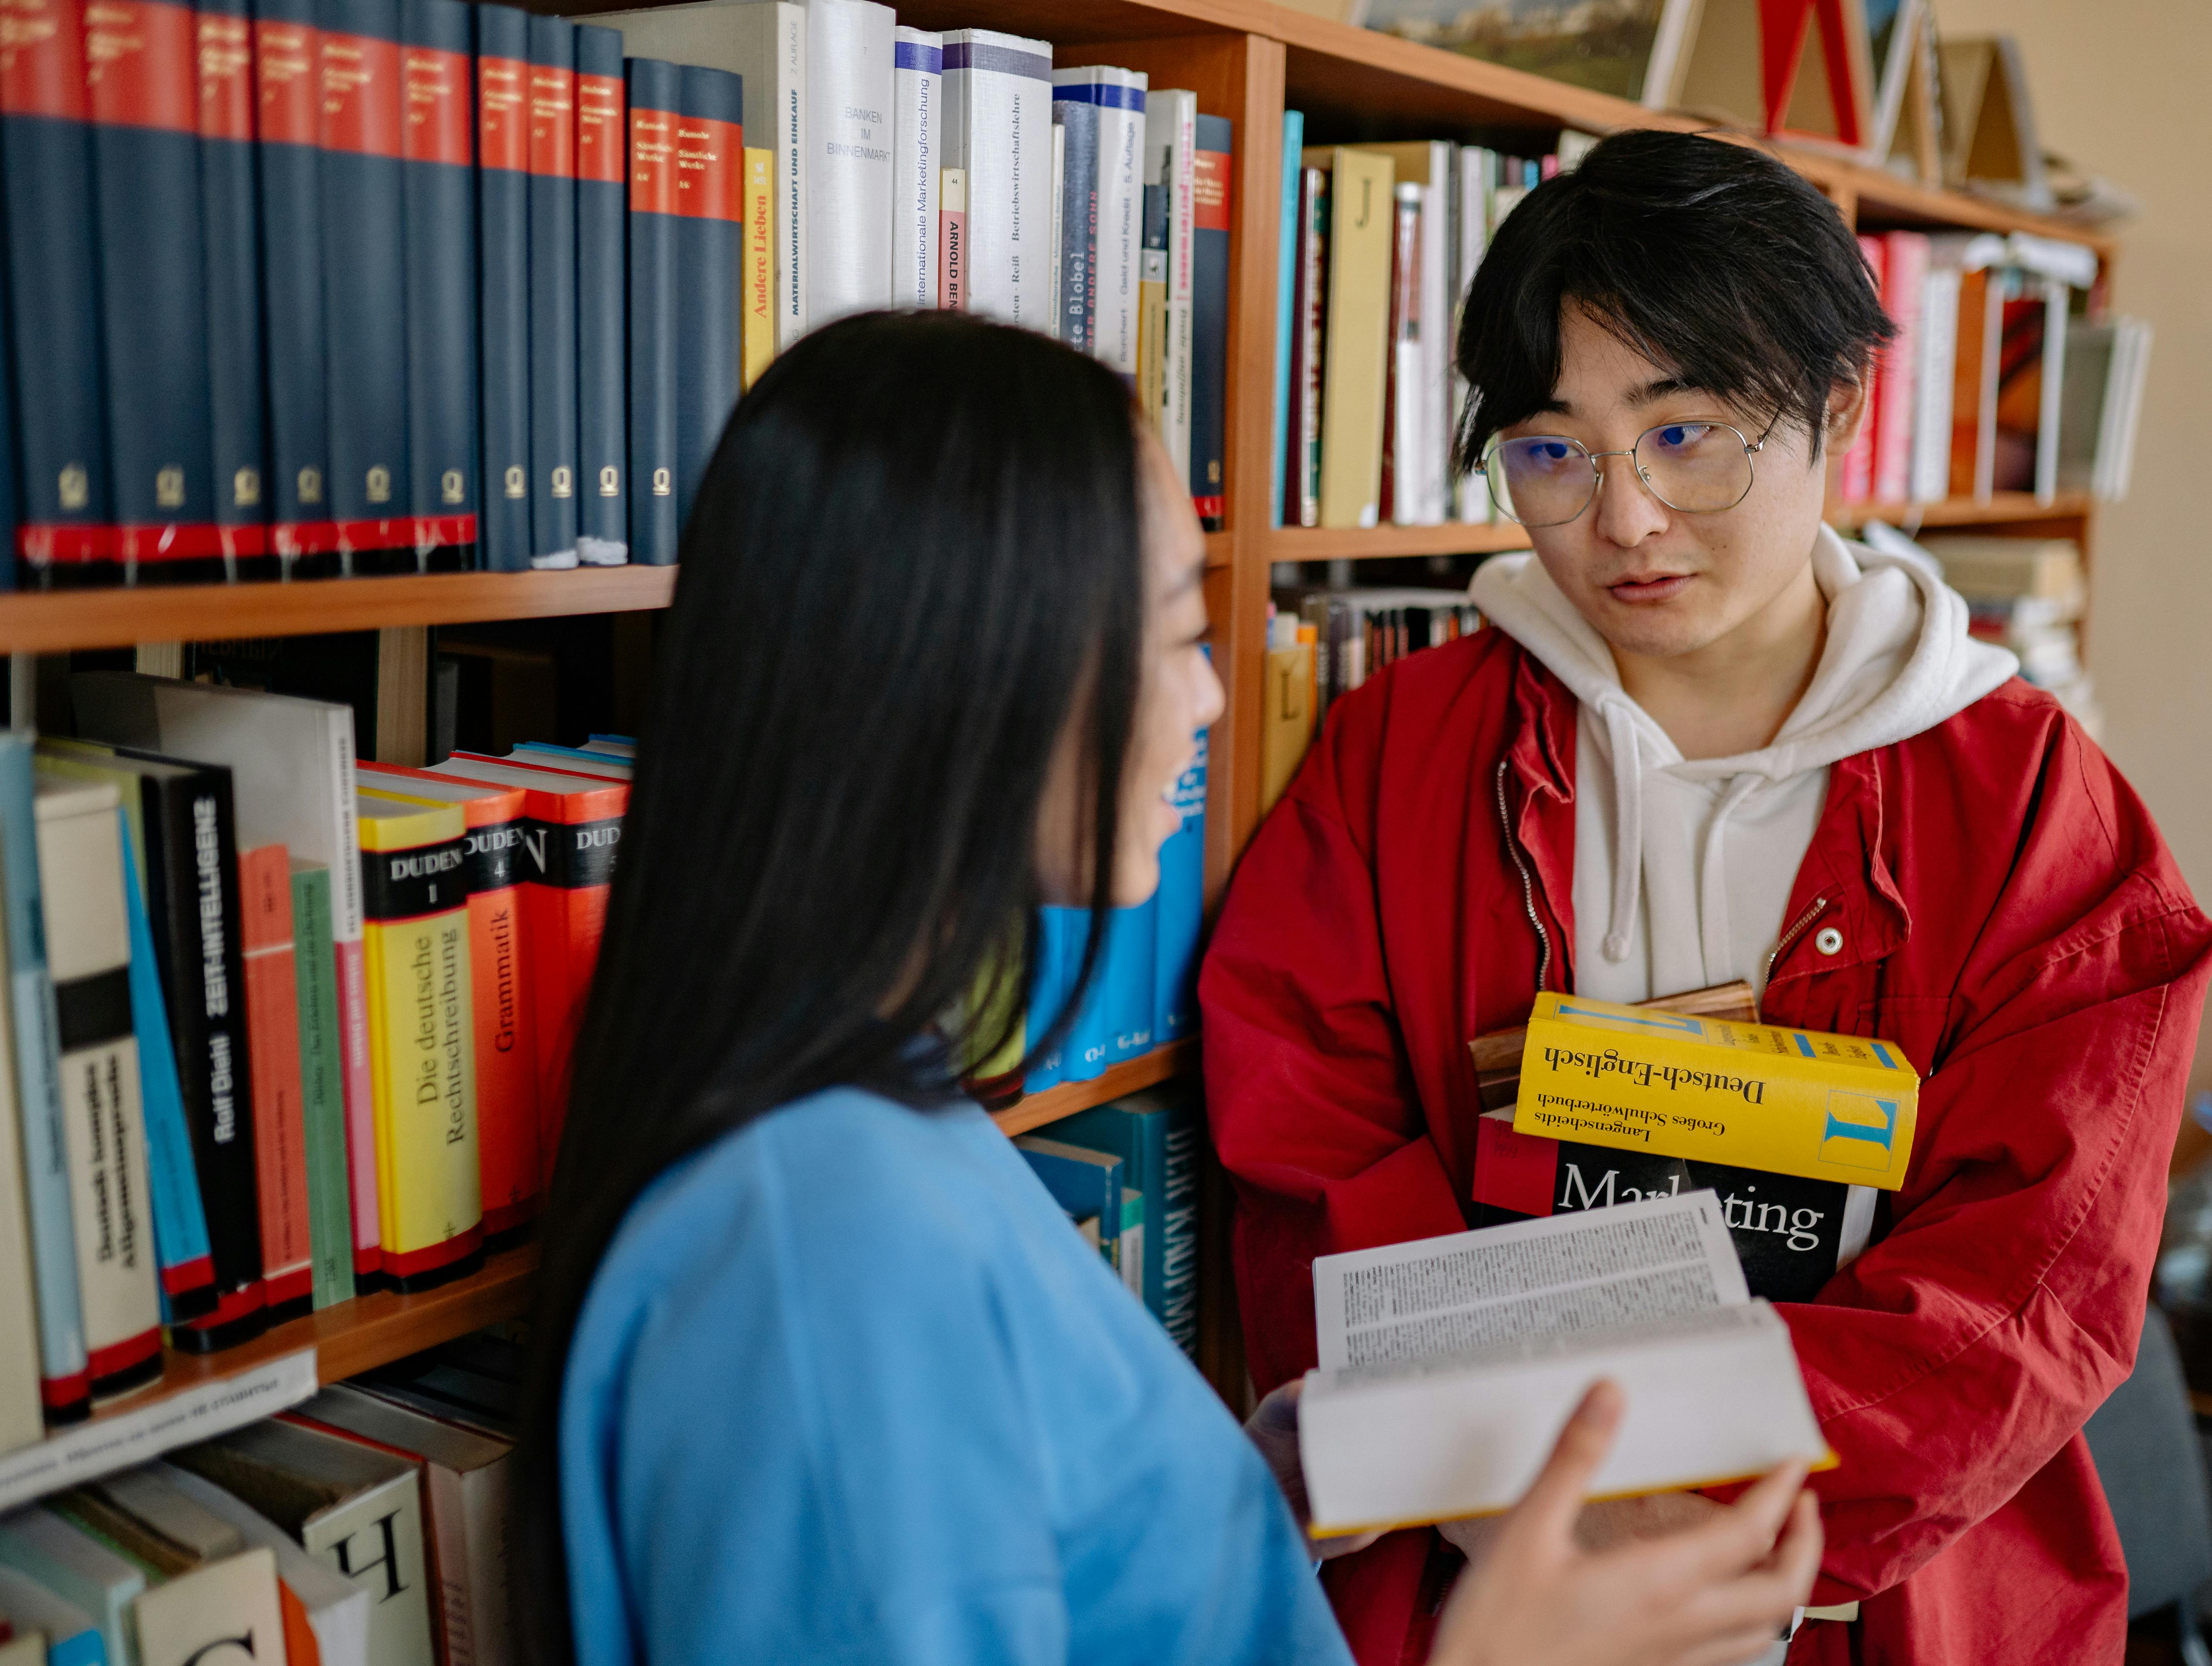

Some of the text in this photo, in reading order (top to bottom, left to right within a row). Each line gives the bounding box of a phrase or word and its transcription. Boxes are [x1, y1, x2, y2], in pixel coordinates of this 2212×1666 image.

[845, 107, 882, 123] BANKEN
[860, 129, 871, 140] IM
[826, 142, 891, 163] BINNENMARKT
[1011, 93, 1020, 242] Betriebswirtschaftslehre
[917, 79, 930, 306] Internationale Marketingforschung
[1089, 190, 1098, 234] SOHN
[754, 195, 767, 253] Lieben
[949, 221, 959, 279] ARNOLD
[1012, 256, 1020, 284] Reiß
[1121, 239, 1129, 262] und
[754, 257, 767, 319] Andere
[1069, 251, 1084, 315] Blobel
[390, 847, 463, 882] DUDEN
[494, 858, 506, 878] 4
[429, 884, 438, 904] 1
[193, 794, 236, 1144] Rolf Diehl ZEIT-INTELLIGENZ
[490, 908, 514, 1053] Grammatik
[411, 935, 438, 1107] Die deutsche
[441, 927, 465, 1147] Rechtschreibung
[1544, 1047, 1766, 1105] Deutsch-Englisch
[1534, 1110, 1651, 1142] Langenscheidts
[1537, 1093, 1725, 1137] Großes Schulwörterbuch
